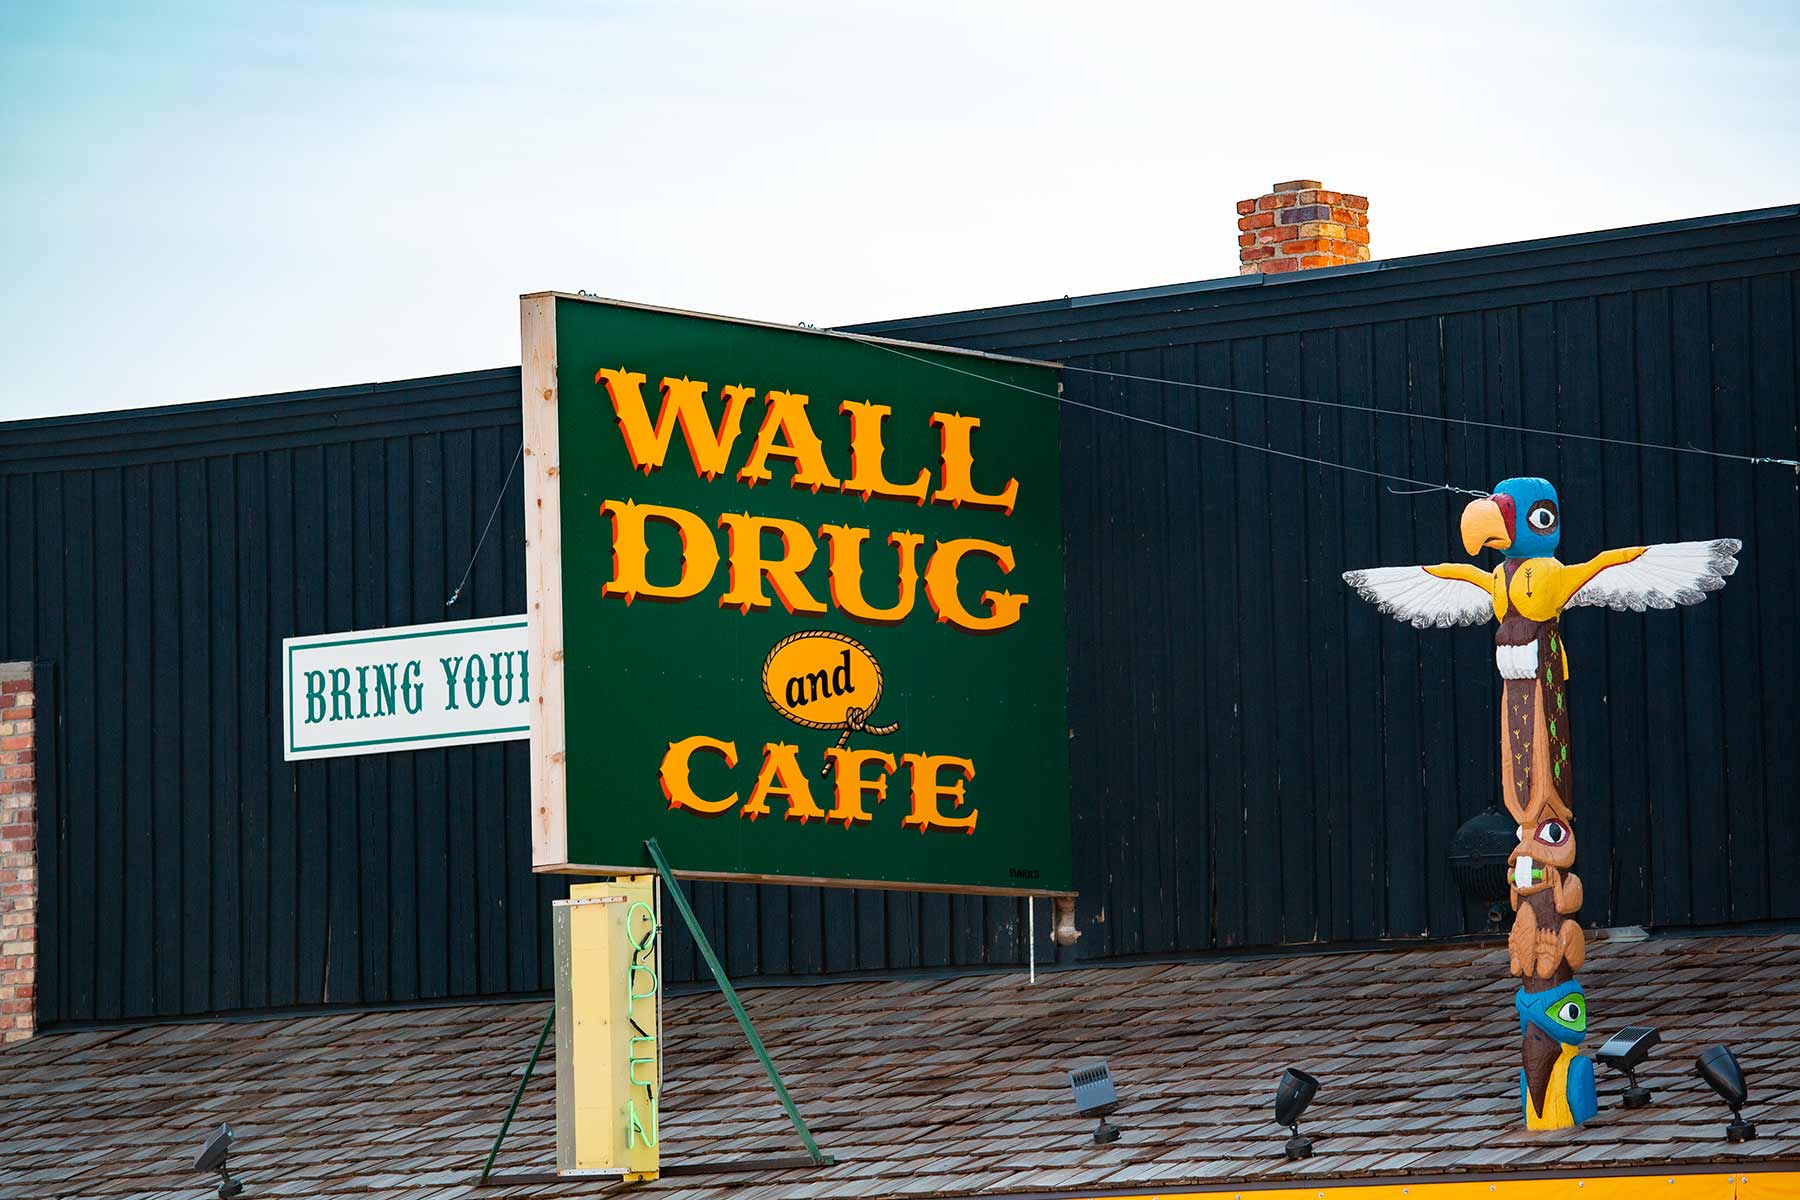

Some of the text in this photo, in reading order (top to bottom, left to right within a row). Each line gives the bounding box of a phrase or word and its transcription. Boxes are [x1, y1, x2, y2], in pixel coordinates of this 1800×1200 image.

[595, 366, 1019, 516] WALL
[600, 497, 1029, 636] DRUG
[304, 660, 424, 724] BRING
[785, 649, 855, 708] and
[657, 735, 978, 835] CAFE
[626, 902, 657, 1149] OPEN
